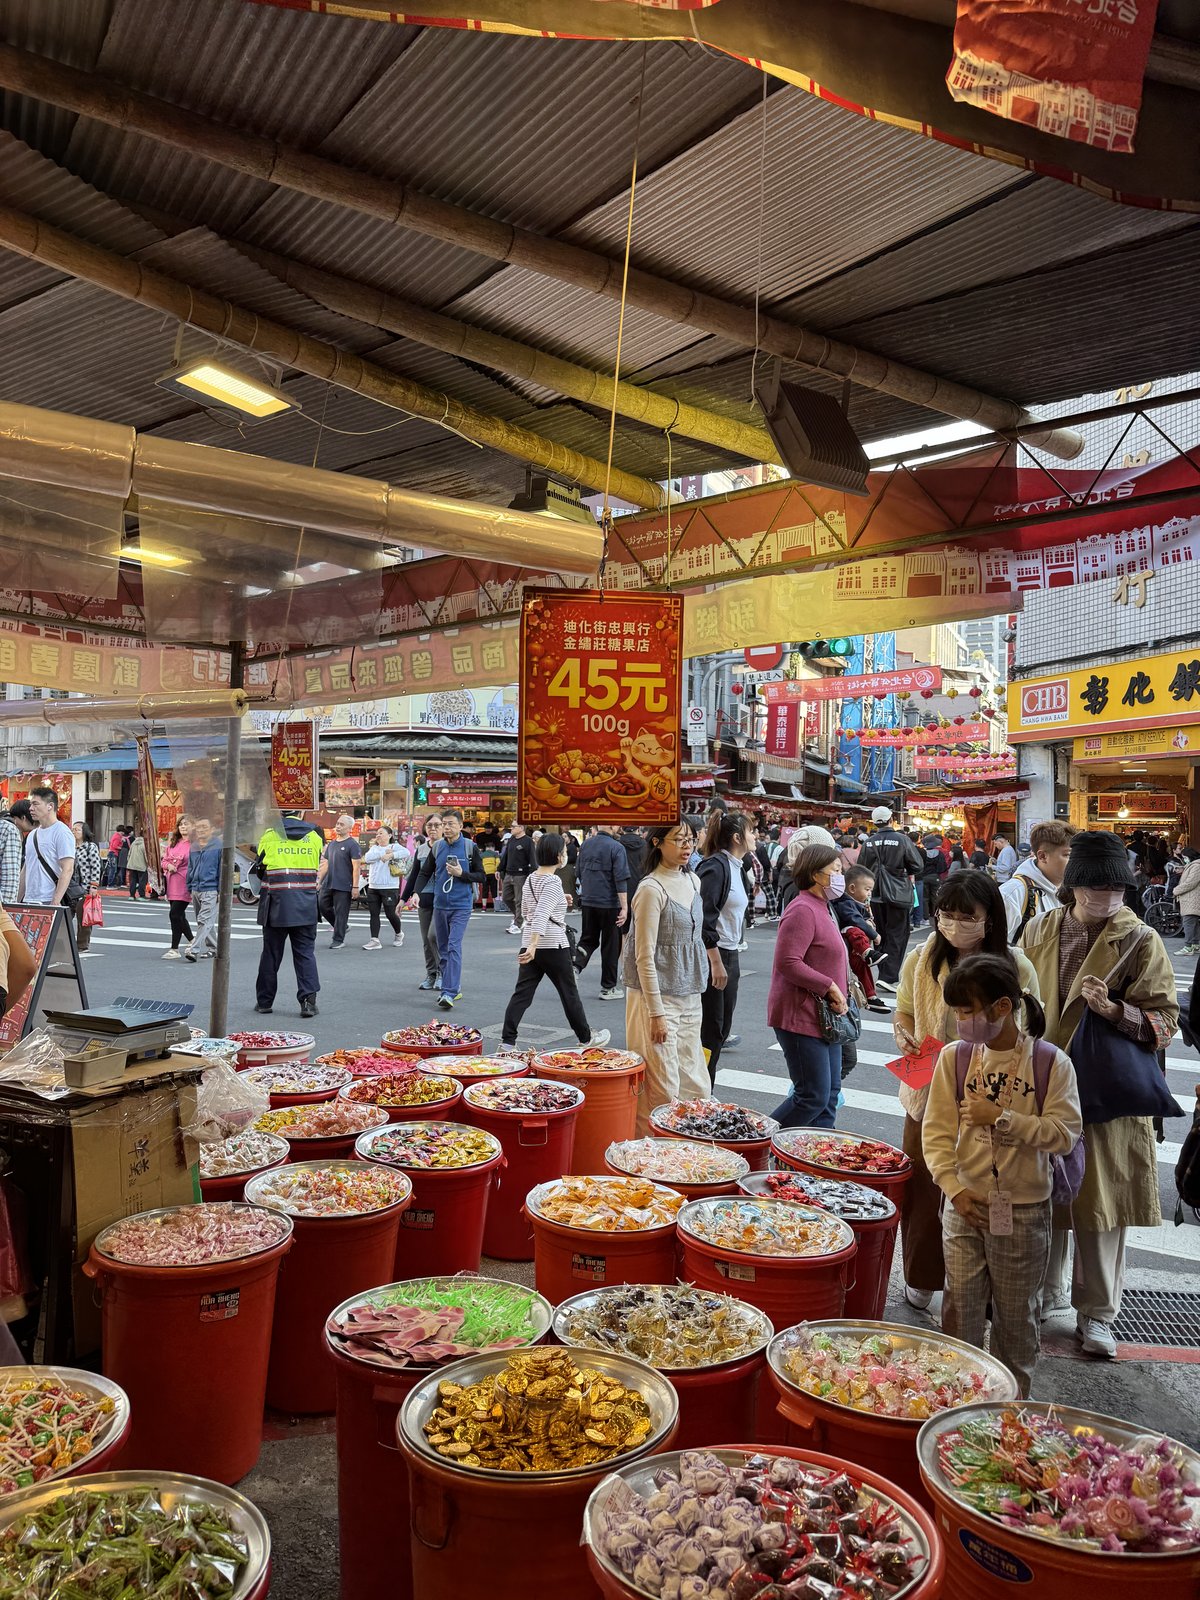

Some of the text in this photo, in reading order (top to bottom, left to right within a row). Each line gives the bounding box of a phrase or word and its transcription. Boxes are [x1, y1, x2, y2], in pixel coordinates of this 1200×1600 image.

[563, 619, 651, 637] 迪化街忠興行
[563, 636, 651, 653] 金繡莊糖果店
[547, 657, 669, 713] 45元
[748, 672, 782, 683] 禁止進入
[1080, 659, 1200, 715] 彰化銀
[1023, 685, 1067, 714] CHB
[489, 716, 518, 729] 龍紋
[580, 713, 630, 737] 100g
[775, 705, 788, 749] 華泰銀行
[1021, 717, 1040, 725] CHANG
[1053, 713, 1068, 721] BANK
[278, 747, 311, 767] 45元
[287, 767, 301, 777] 100g
[277, 847, 313, 855] POLICE
[966, 1071, 1036, 1098] MICKEY
